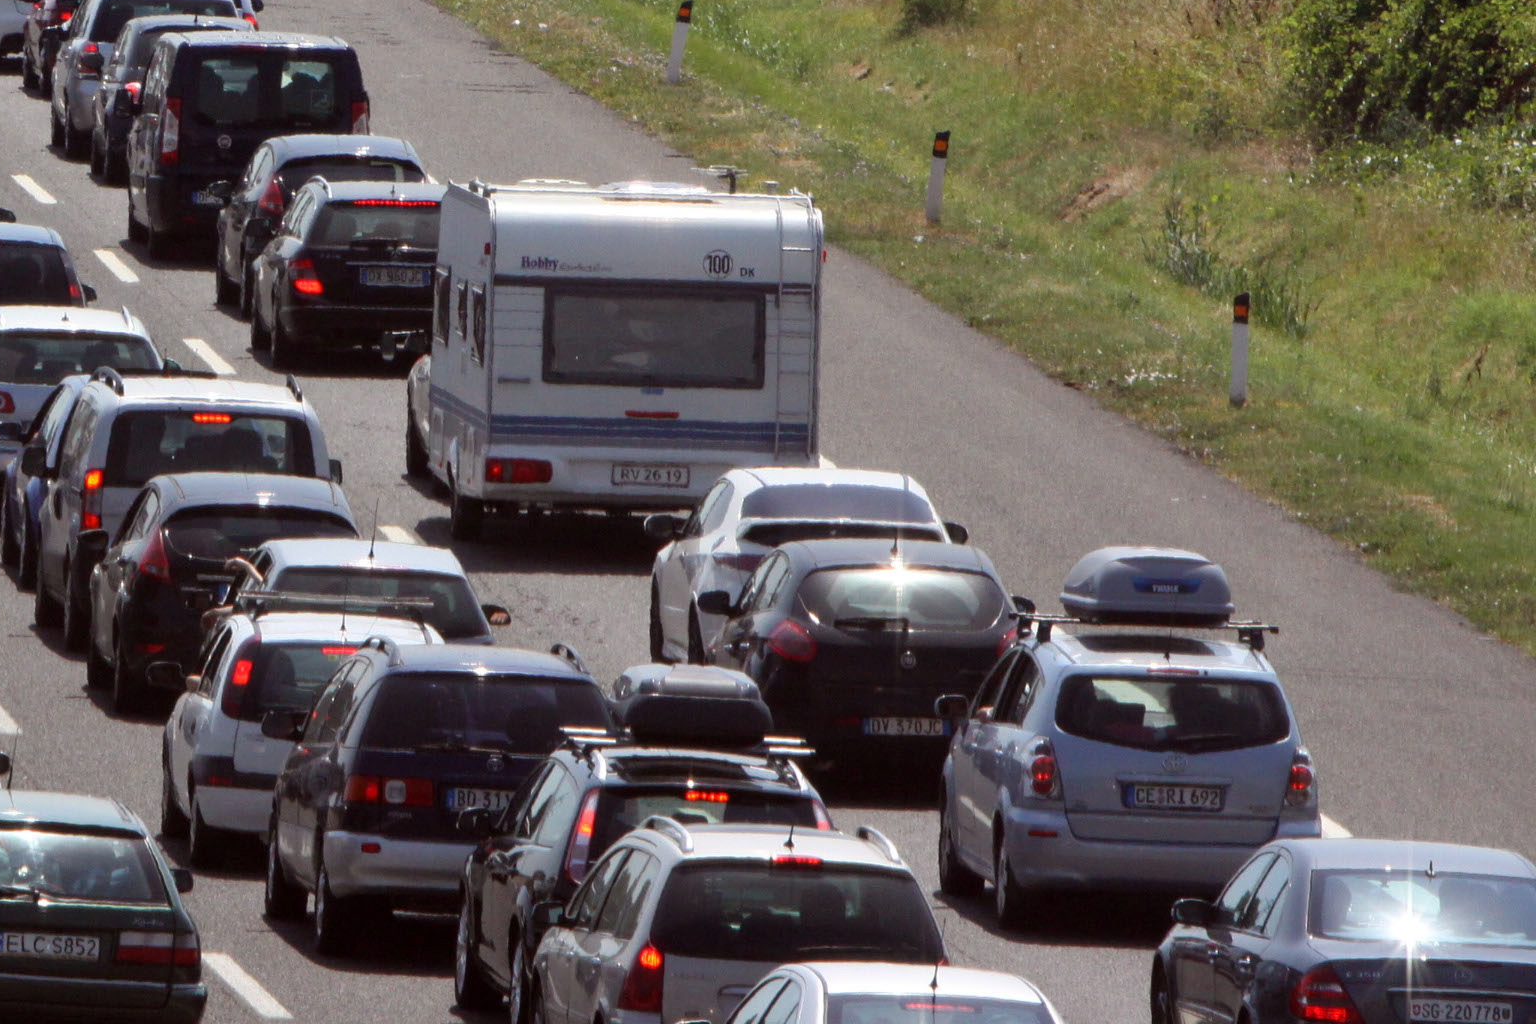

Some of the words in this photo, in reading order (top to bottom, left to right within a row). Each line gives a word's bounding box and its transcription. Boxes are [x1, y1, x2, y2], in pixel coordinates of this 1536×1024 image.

[520, 255, 559, 272] Hobby
[705, 254, 731, 274] 100
[739, 267, 755, 278] DK
[620, 468, 640, 481] RV
[644, 469, 661, 481] 26
[667, 470, 682, 482] 19
[871, 718, 889, 734] DV
[1135, 787, 1155, 804] CE
[1190, 789, 1218, 806] 692
[6, 935, 47, 953] ELC
[52, 937, 97, 957] S852
[1421, 1003, 1440, 1019] SG
[1445, 1004, 1501, 1022] 220778
